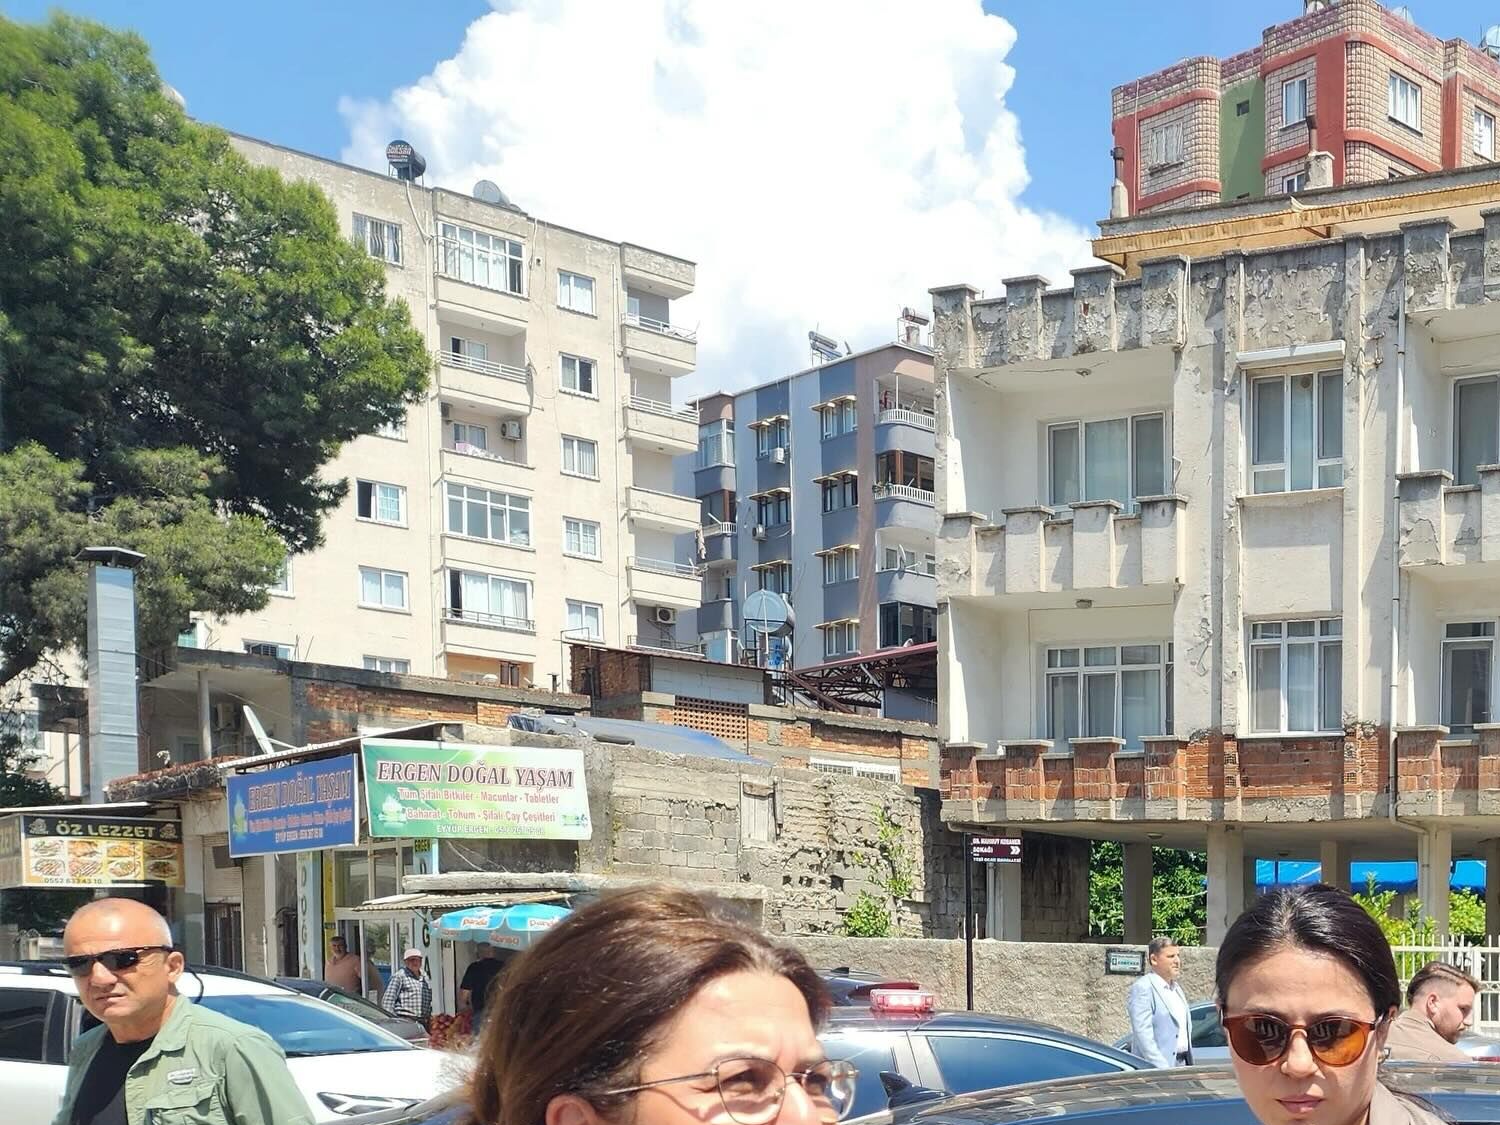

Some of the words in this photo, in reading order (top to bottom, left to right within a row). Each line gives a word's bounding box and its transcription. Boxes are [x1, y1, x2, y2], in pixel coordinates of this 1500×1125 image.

[377, 761, 442, 782] ERGEN
[447, 760, 511, 786] DOĞAL
[515, 767, 574, 792] YAŞAM
[248, 783, 280, 813] ERGEN
[281, 771, 315, 808] DOĞAL
[316, 769, 352, 808] YAŞAM
[398, 788, 417, 799] Tüm
[443, 789, 474, 801] Bitkiler
[480, 791, 518, 803] Macunlar
[524, 792, 560, 804] Tabletler
[406, 808, 441, 820] Baharat
[448, 808, 476, 820] Tohum
[505, 810, 520, 823] Çay
[522, 811, 556, 823] Çeşitleri
[56, 820, 83, 836] ÖZ
[87, 824, 156, 838] LEZZET
